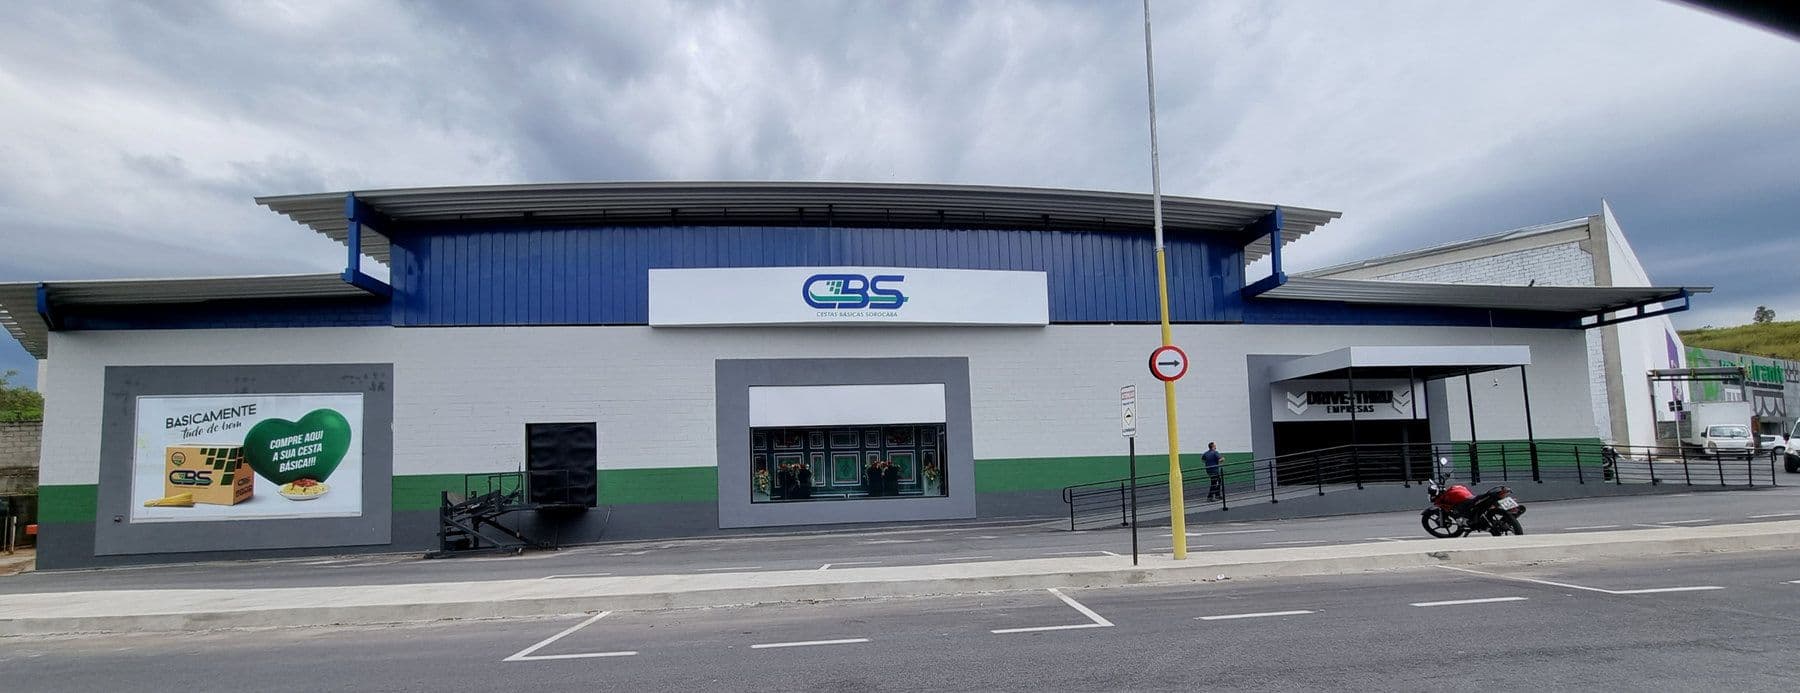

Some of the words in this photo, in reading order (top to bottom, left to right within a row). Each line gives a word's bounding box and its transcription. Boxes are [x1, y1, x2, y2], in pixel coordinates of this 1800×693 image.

[802, 274, 909, 309] CBS
[165, 403, 257, 429] BASICAMENTE
[180, 426, 204, 440] tudo
[206, 422, 220, 434] de
[269, 434, 304, 450] COMPRE
[304, 430, 324, 443] AQUI
[272, 451, 279, 462] A
[280, 448, 296, 460] SUA
[297, 442, 322, 456] CESTA
[169, 469, 213, 486] CBS
